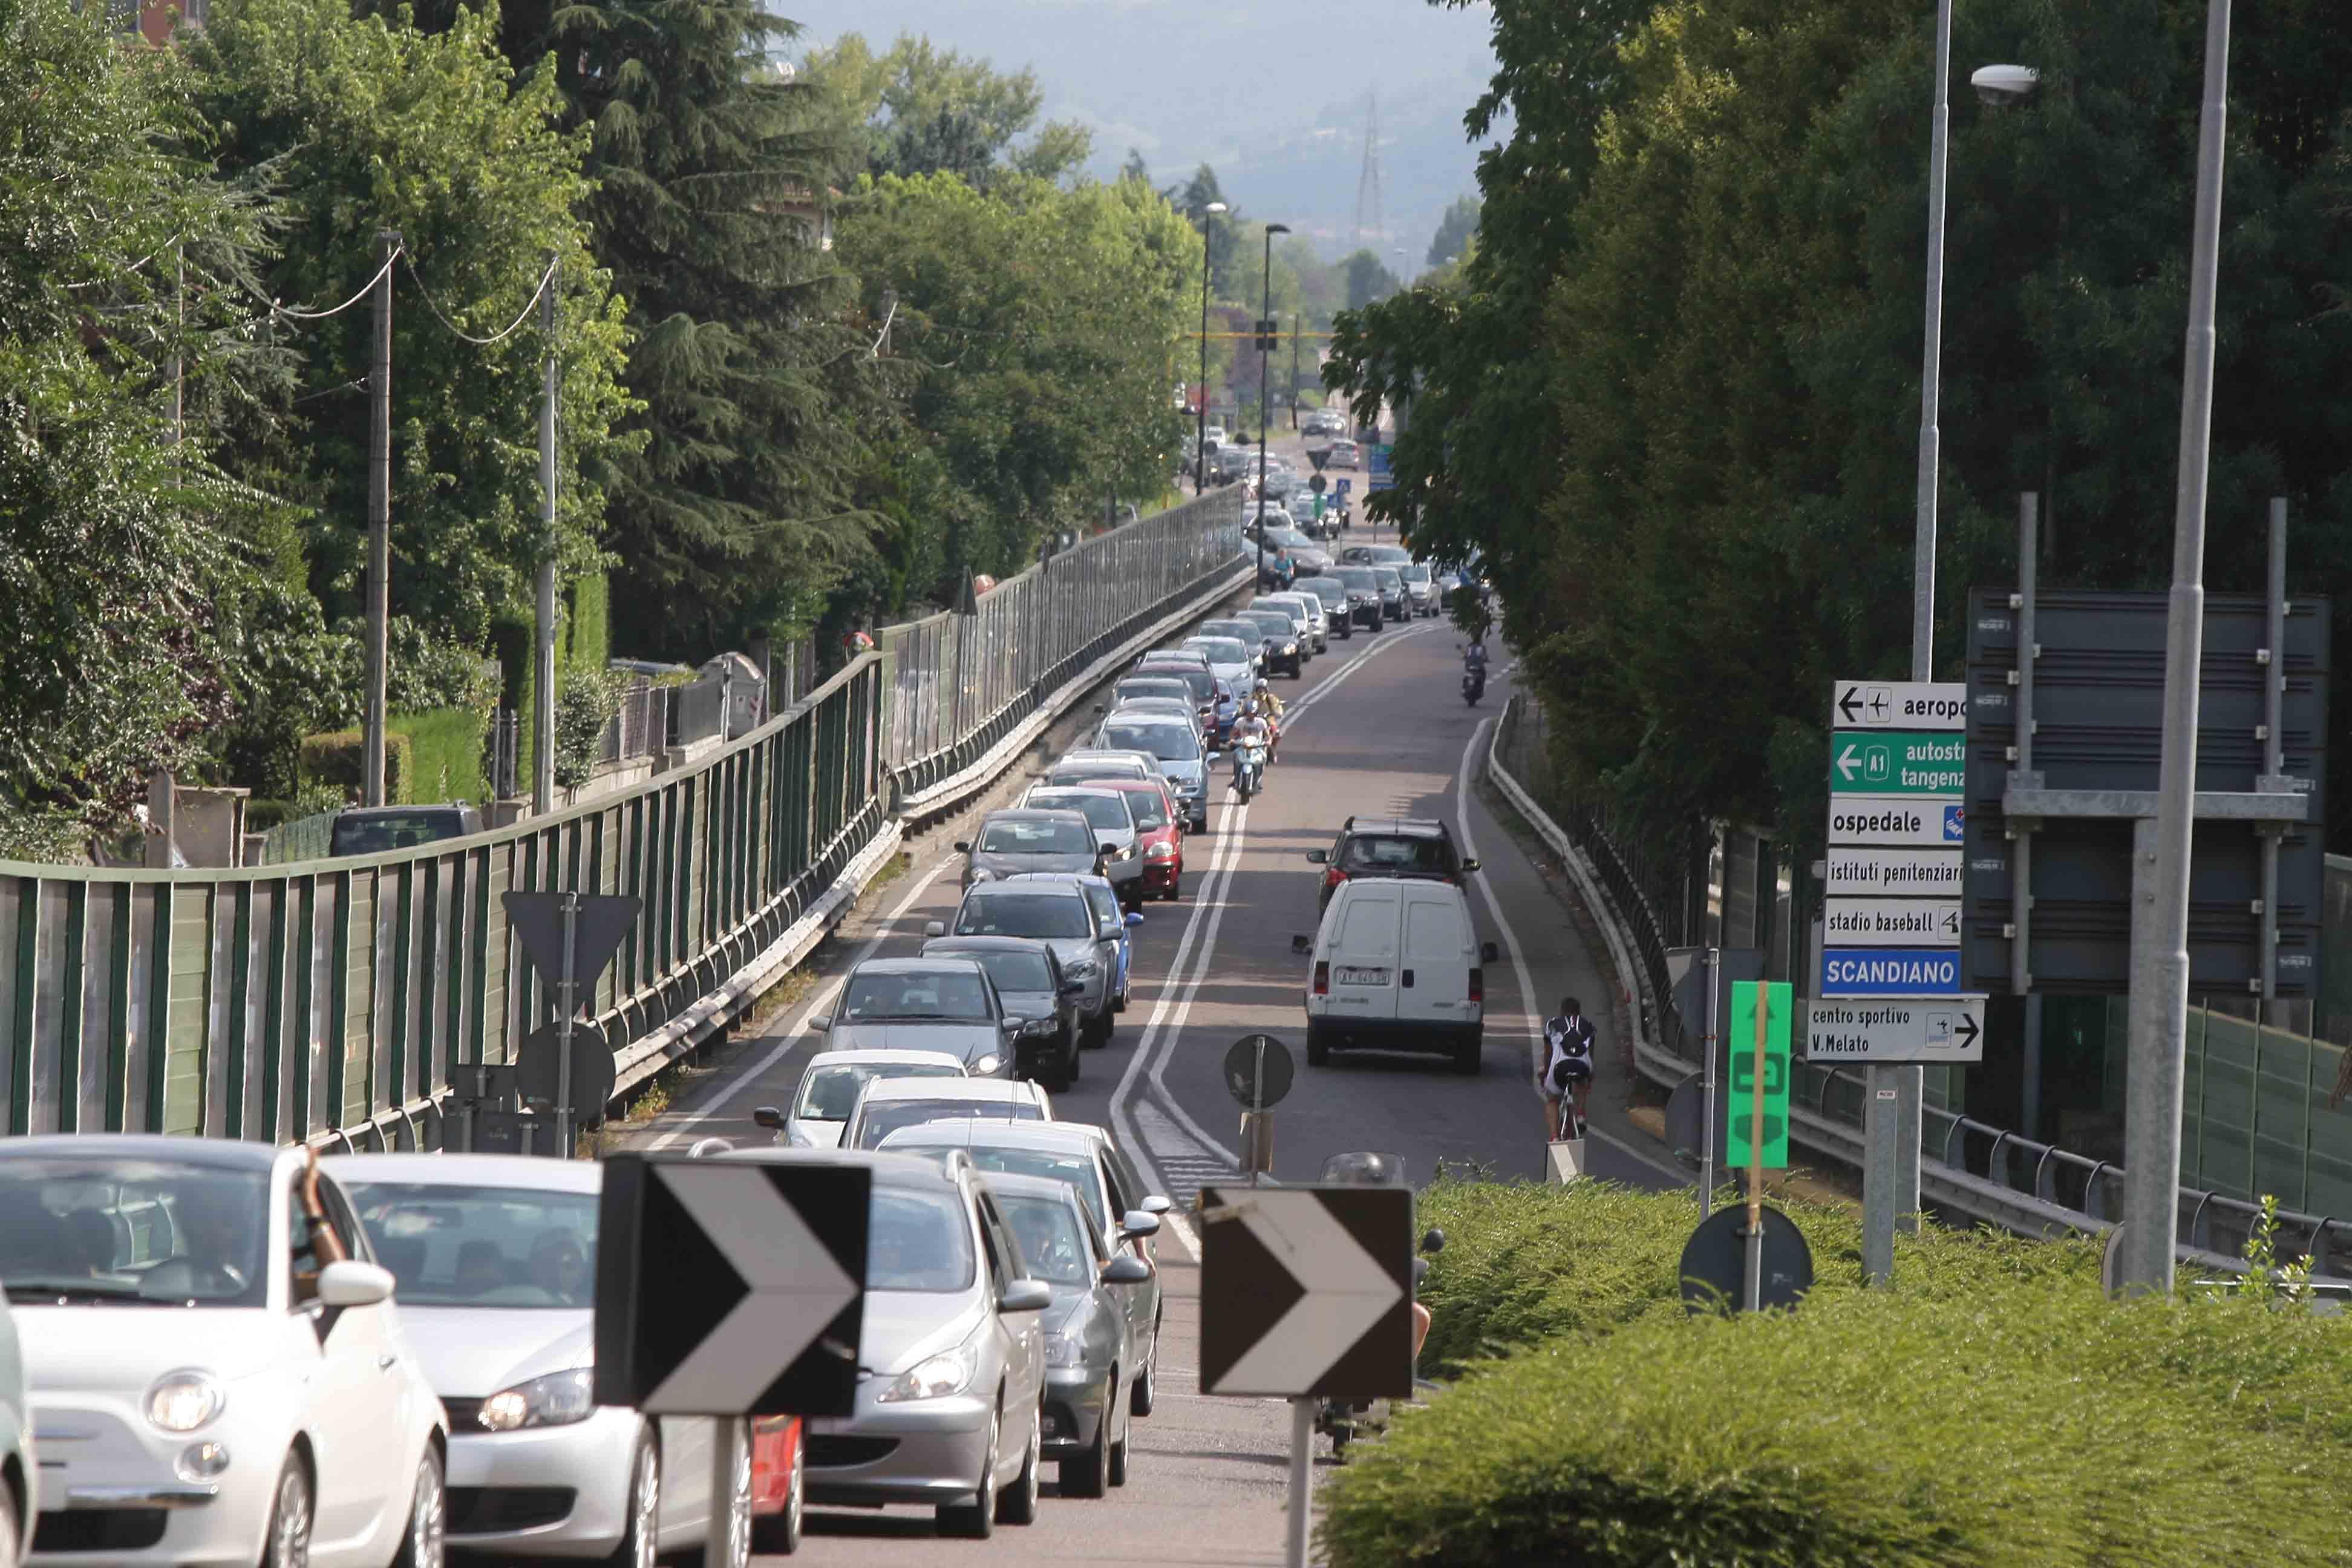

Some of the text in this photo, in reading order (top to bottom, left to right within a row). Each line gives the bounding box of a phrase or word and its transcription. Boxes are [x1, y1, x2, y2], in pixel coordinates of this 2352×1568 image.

[1870, 754, 1884, 772] A1
[1834, 811, 1921, 834] ospedale
[1831, 862, 1878, 881] istituti
[1829, 912, 1933, 932] stadio baseball
[1827, 961, 1955, 983] SCANDIANO
[1813, 1007, 1910, 1028] centro sportivo
[1812, 1034, 1869, 1053] V.Melato
